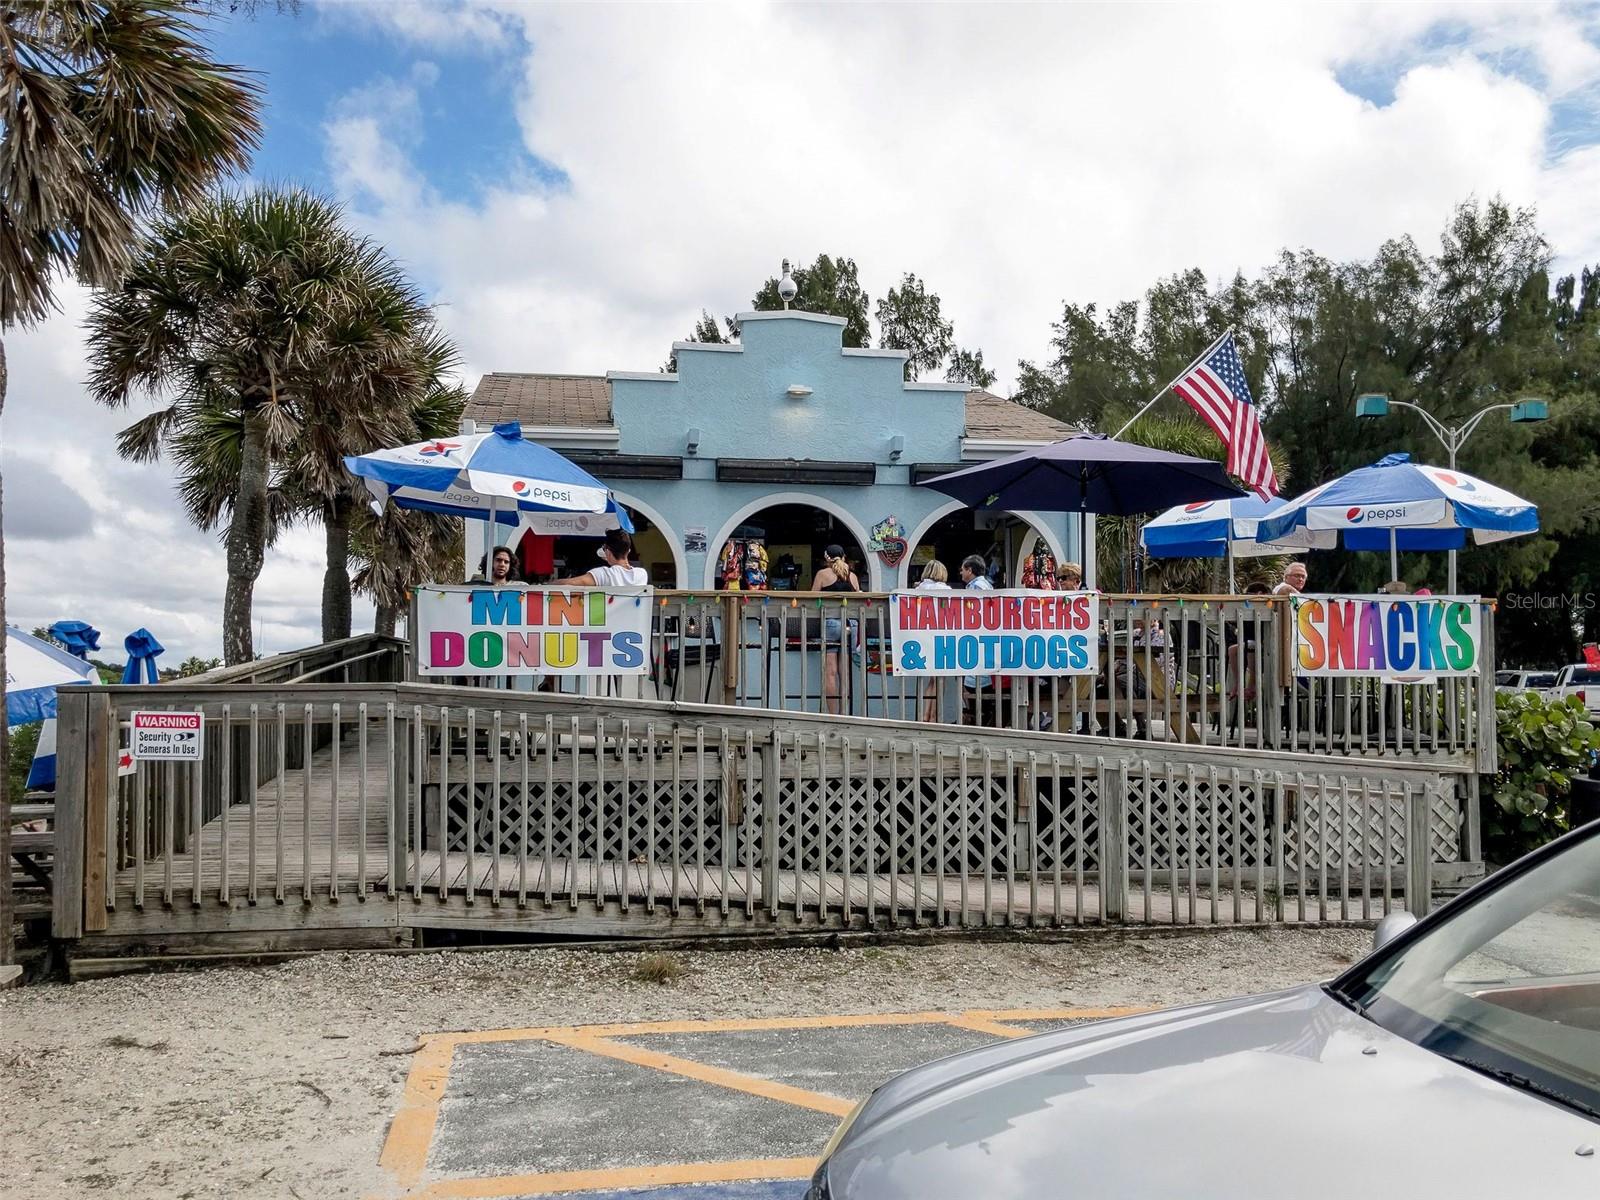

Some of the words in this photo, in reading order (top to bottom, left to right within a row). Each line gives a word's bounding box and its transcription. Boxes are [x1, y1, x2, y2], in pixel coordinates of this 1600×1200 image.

[533, 487, 571, 502] pepsi
[1367, 507, 1406, 521] pepsi
[471, 589, 606, 627] MINI
[899, 596, 1091, 631] HAMBURGERS
[1298, 600, 1475, 671] SNACKS
[430, 631, 644, 668] DONUTS
[901, 640, 927, 670] &
[934, 634, 1089, 670] HOTDOGS
[139, 716, 197, 728] WARNING
[138, 743, 171, 754] Cameras
[173, 744, 180, 754] In
[182, 744, 196, 755] Use
[139, 731, 172, 743] Security
